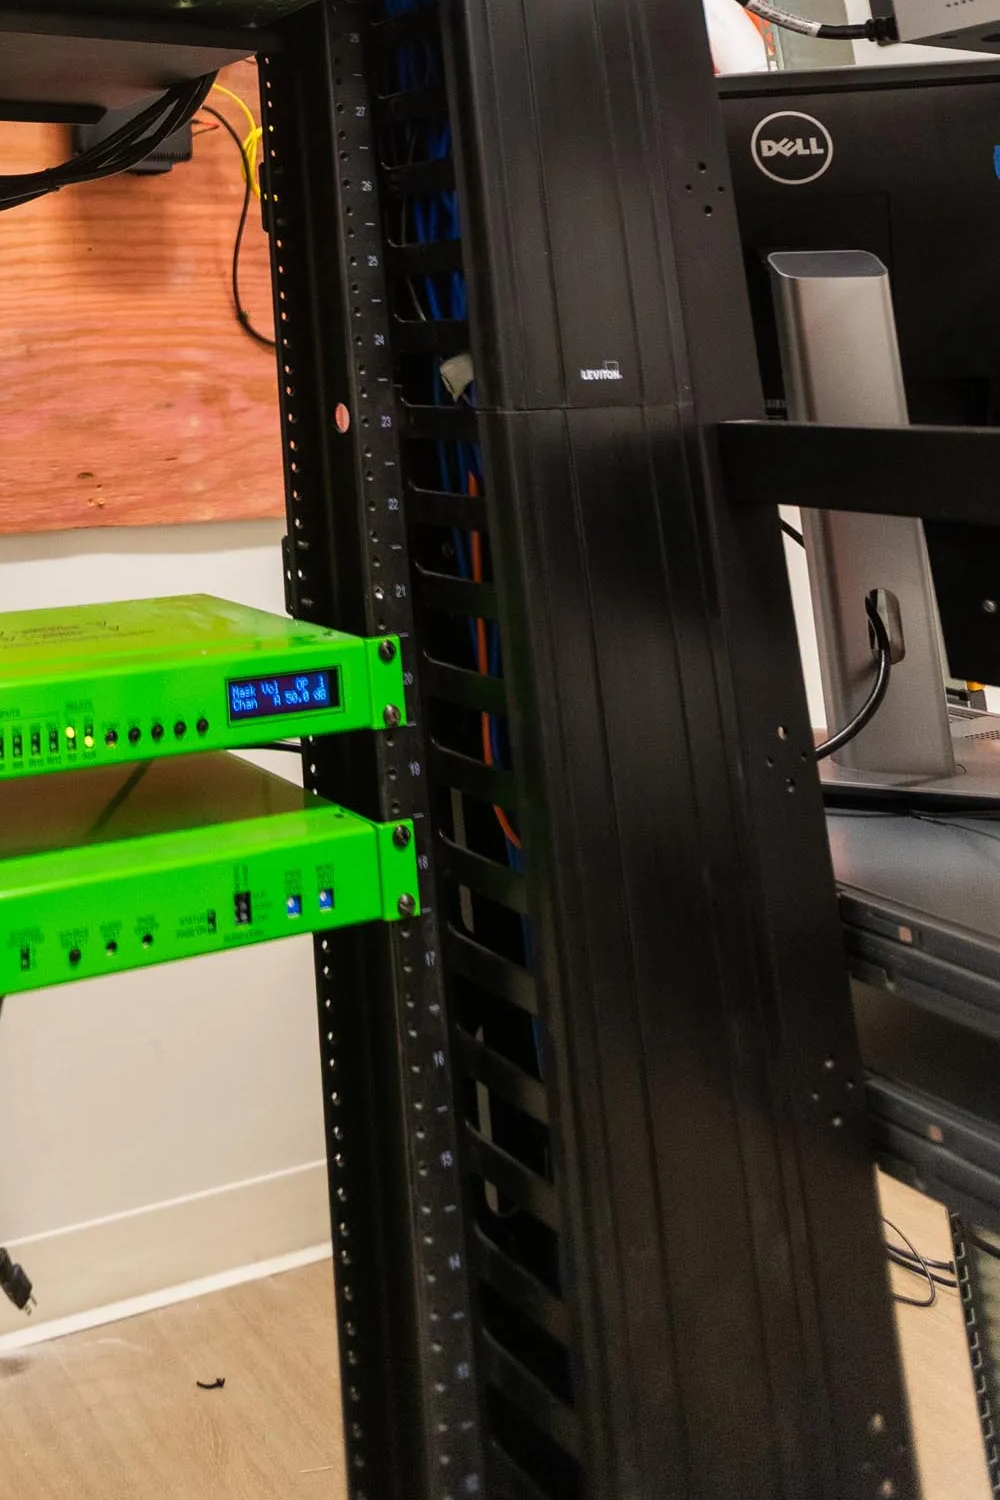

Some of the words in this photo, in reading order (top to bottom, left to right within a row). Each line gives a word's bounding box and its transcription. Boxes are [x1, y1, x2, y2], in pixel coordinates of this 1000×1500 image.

[355, 106, 366, 117] 27
[760, 137, 824, 157] DELL
[361, 180, 373, 192] 26
[367, 255, 379, 267] 25
[374, 333, 385, 347] 24
[580, 369, 620, 380] LEVITON
[381, 415, 392, 428] 23
[388, 498, 399, 511] 22
[396, 584, 406, 598] 21
[403, 672, 414, 686] 20
[231, 684, 257, 700] Mask
[260, 679, 279, 695] Vol
[232, 698, 258, 712] Chan
[274, 694, 282, 706] A
[408, 761, 422, 777] 19
[425, 950, 436, 967] 17
